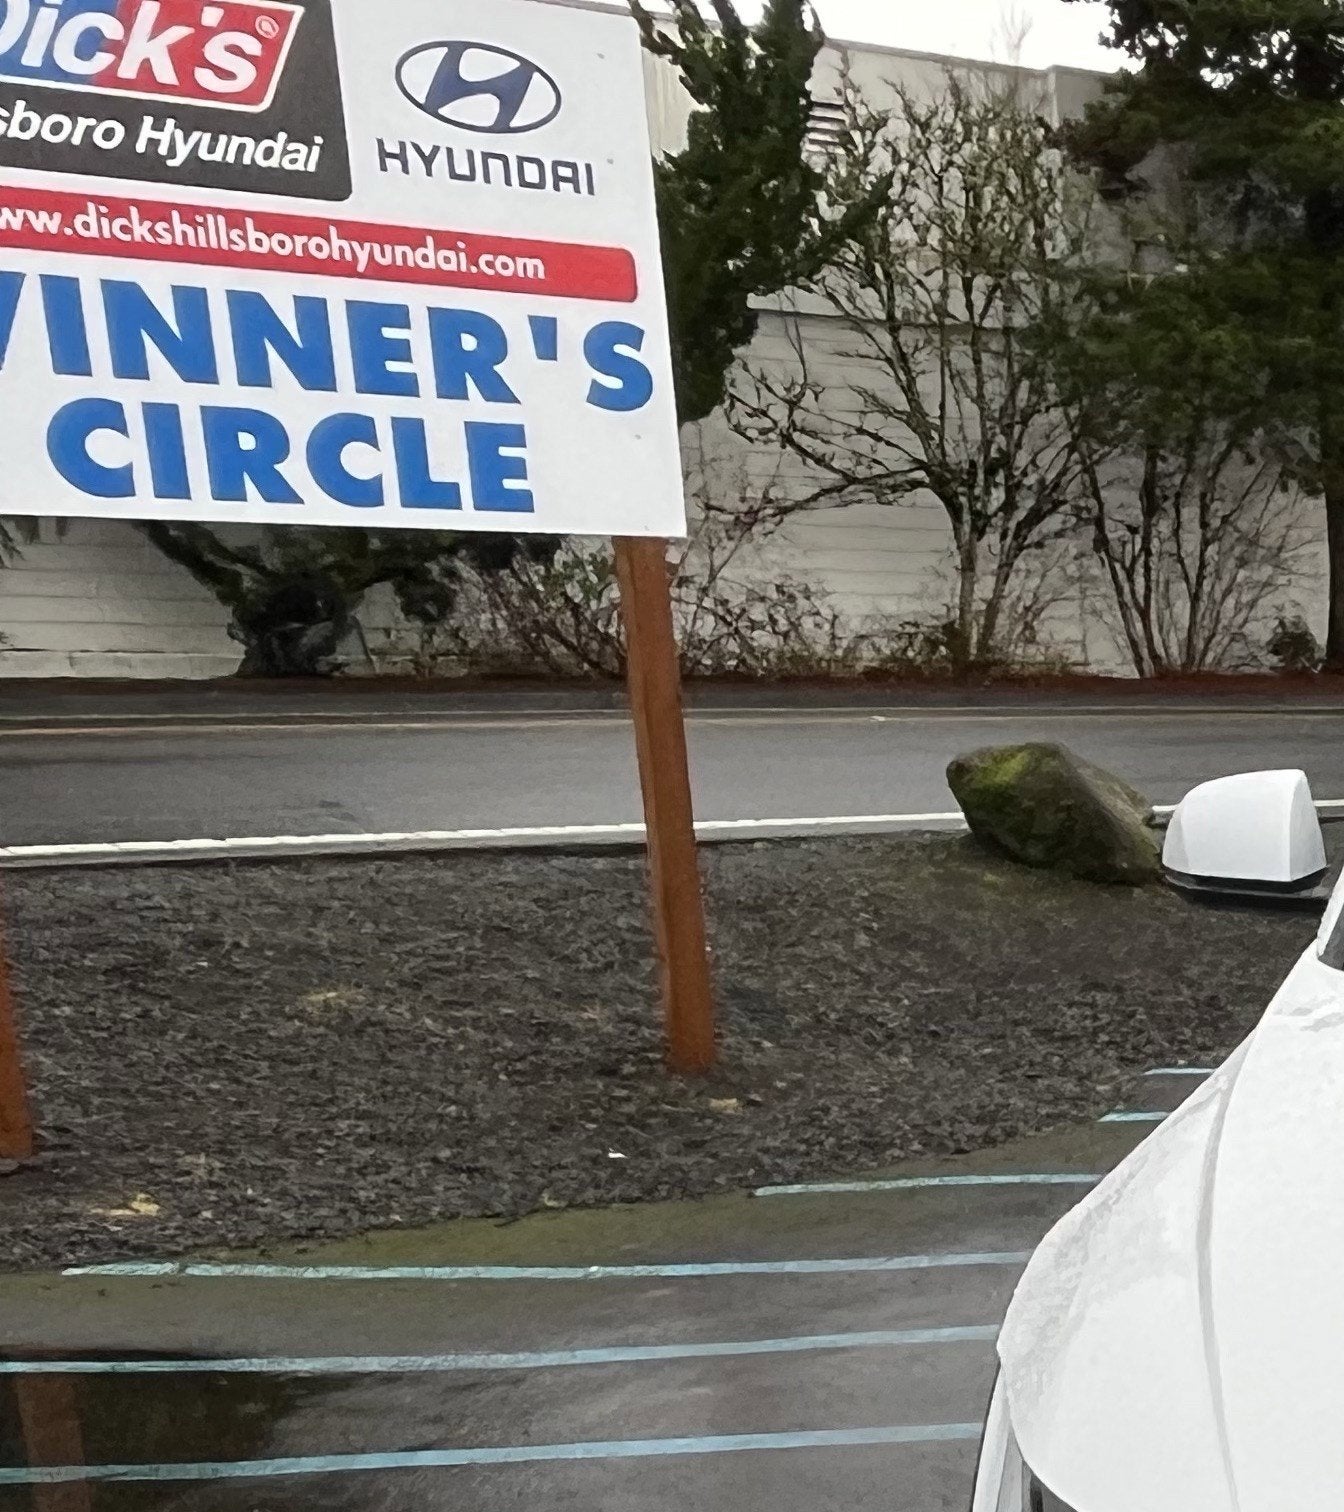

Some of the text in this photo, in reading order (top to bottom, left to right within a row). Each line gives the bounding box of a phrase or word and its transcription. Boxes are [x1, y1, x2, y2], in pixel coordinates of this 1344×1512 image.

[135, 115, 325, 173] Hyundai
[375, 137, 596, 197] HYUNDAI
[0, 271, 654, 412] INNER'S
[46, 398, 536, 514] CIRCLE
